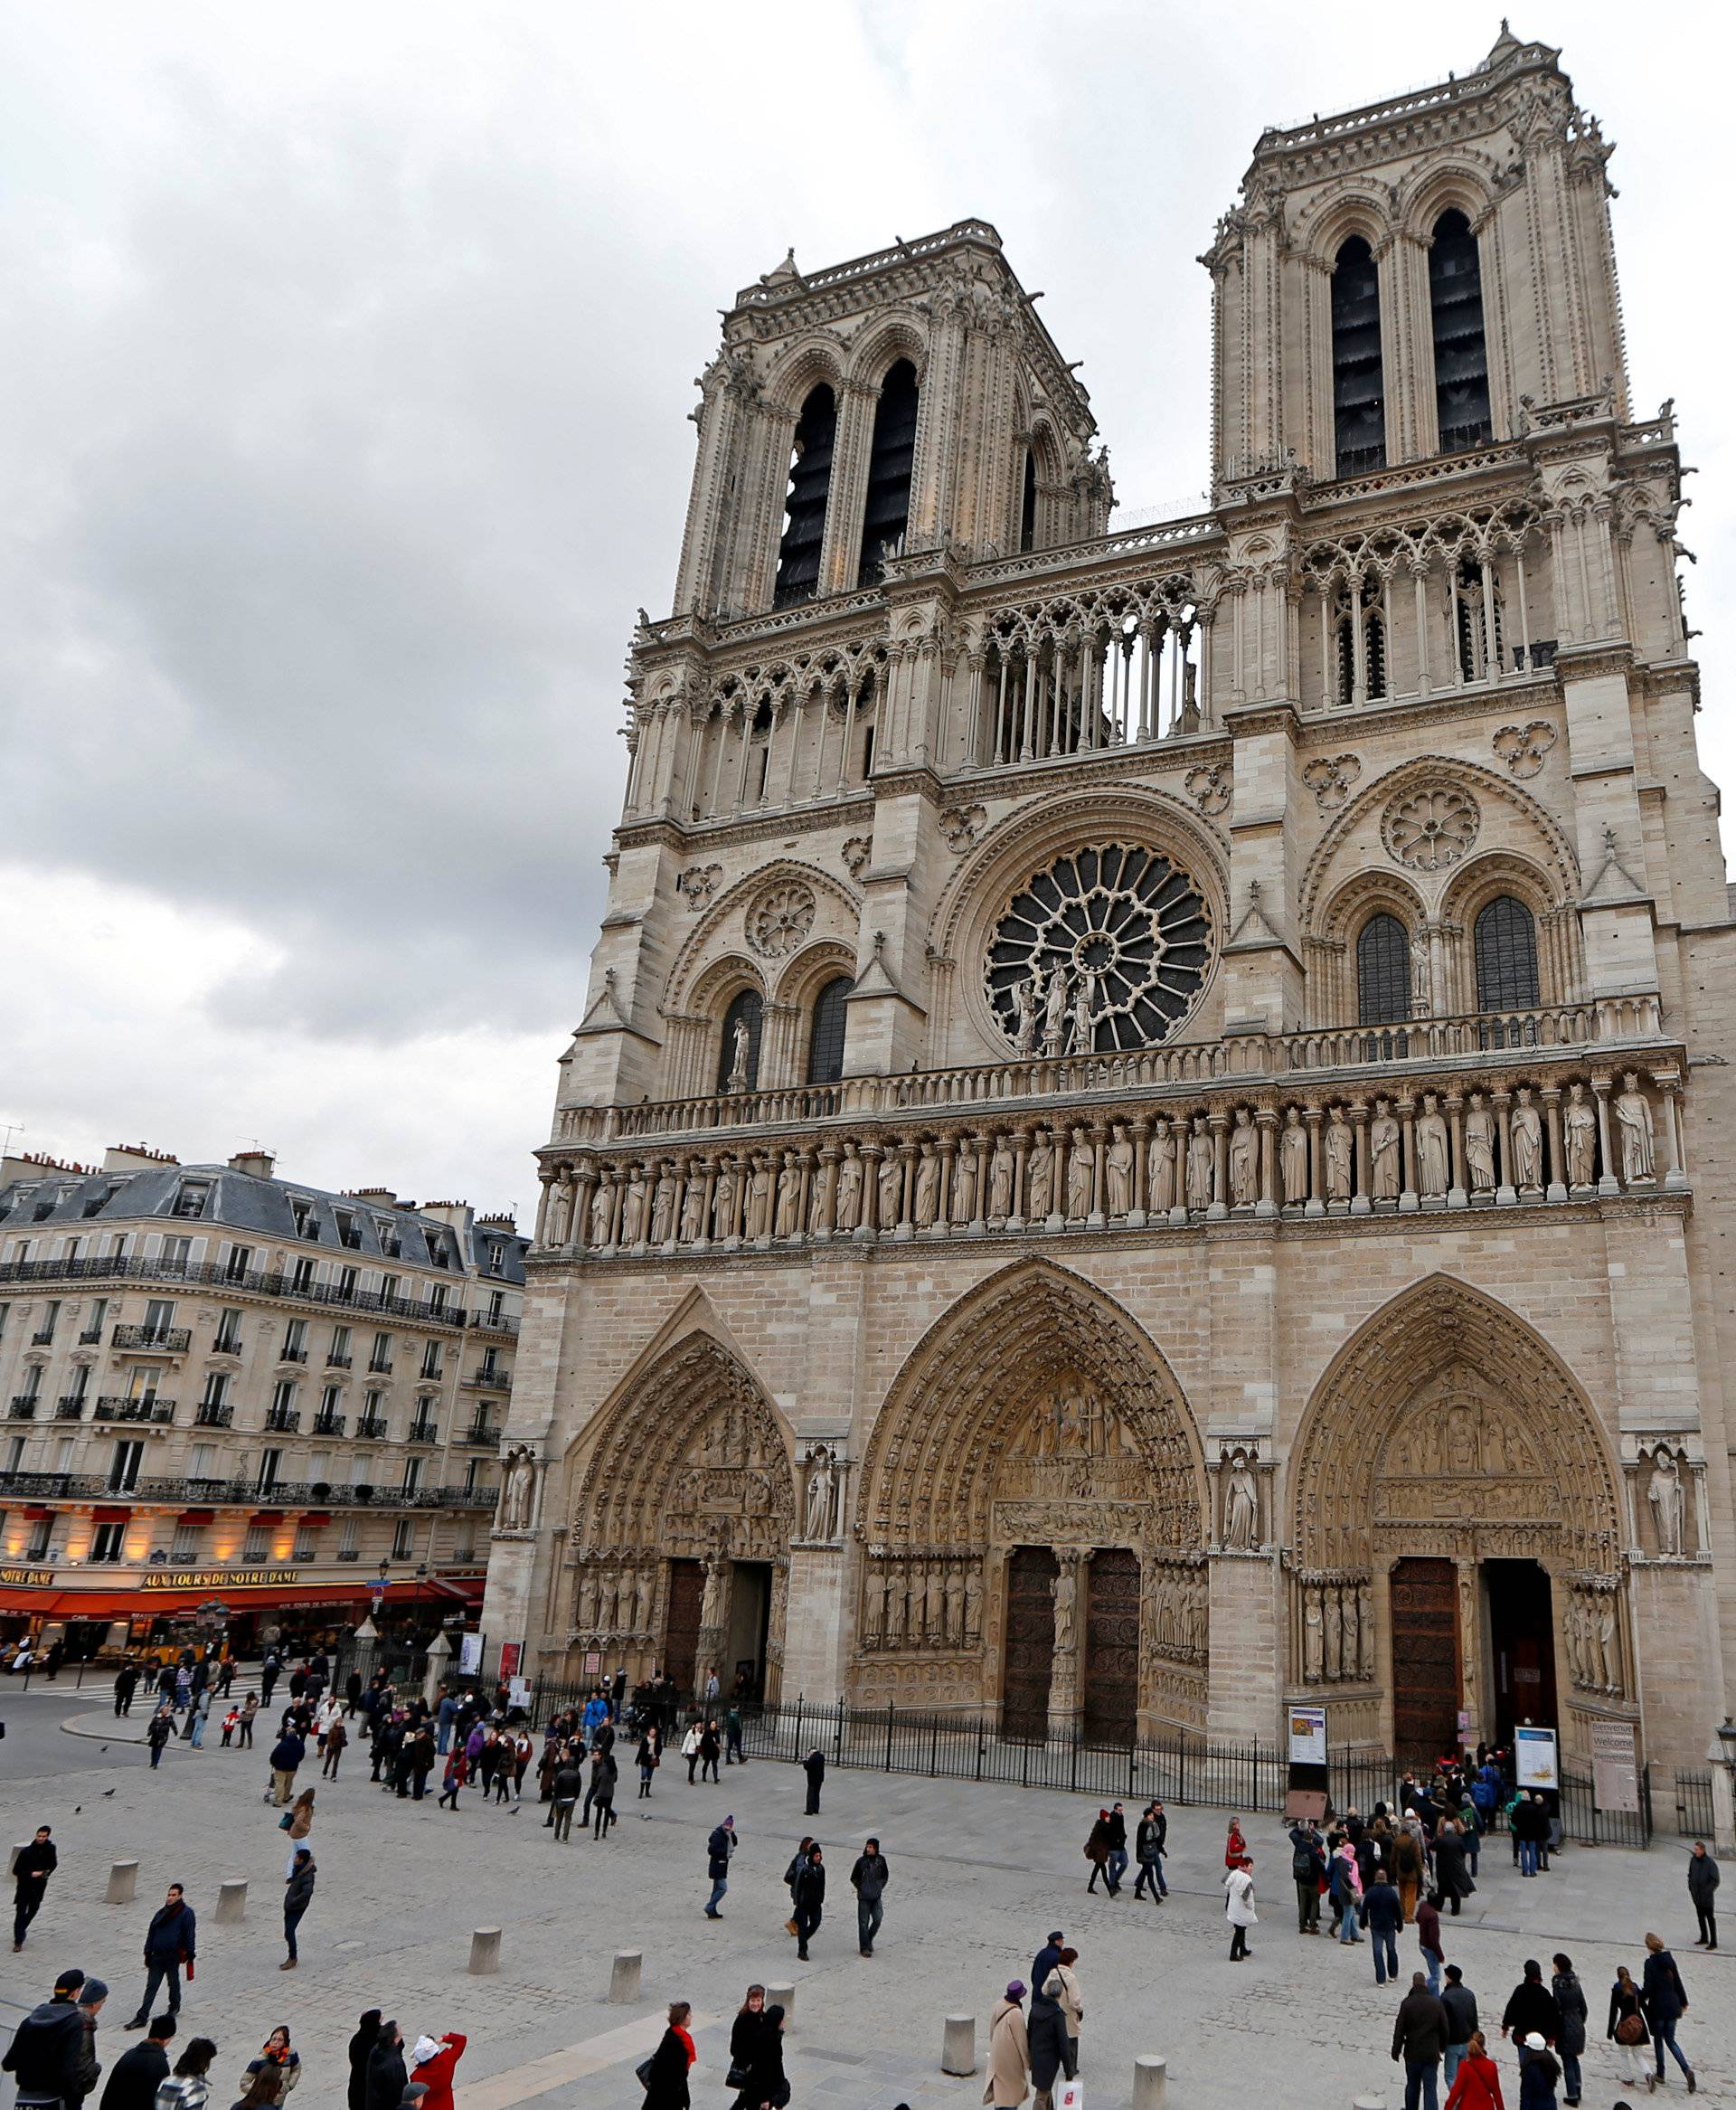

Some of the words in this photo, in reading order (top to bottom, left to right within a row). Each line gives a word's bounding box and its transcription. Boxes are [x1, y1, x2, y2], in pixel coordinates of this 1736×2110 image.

[28, 1571, 52, 1585] DAME
[145, 1574, 167, 1586] AUX
[172, 1574, 209, 1586] TOURS
[211, 1573, 225, 1585] DE
[230, 1572, 265, 1584] NOTRE
[268, 1571, 299, 1583] DAME
[1592, 1722, 1633, 1732] Bienvenue
[1593, 1737, 1634, 1747] Welcome
